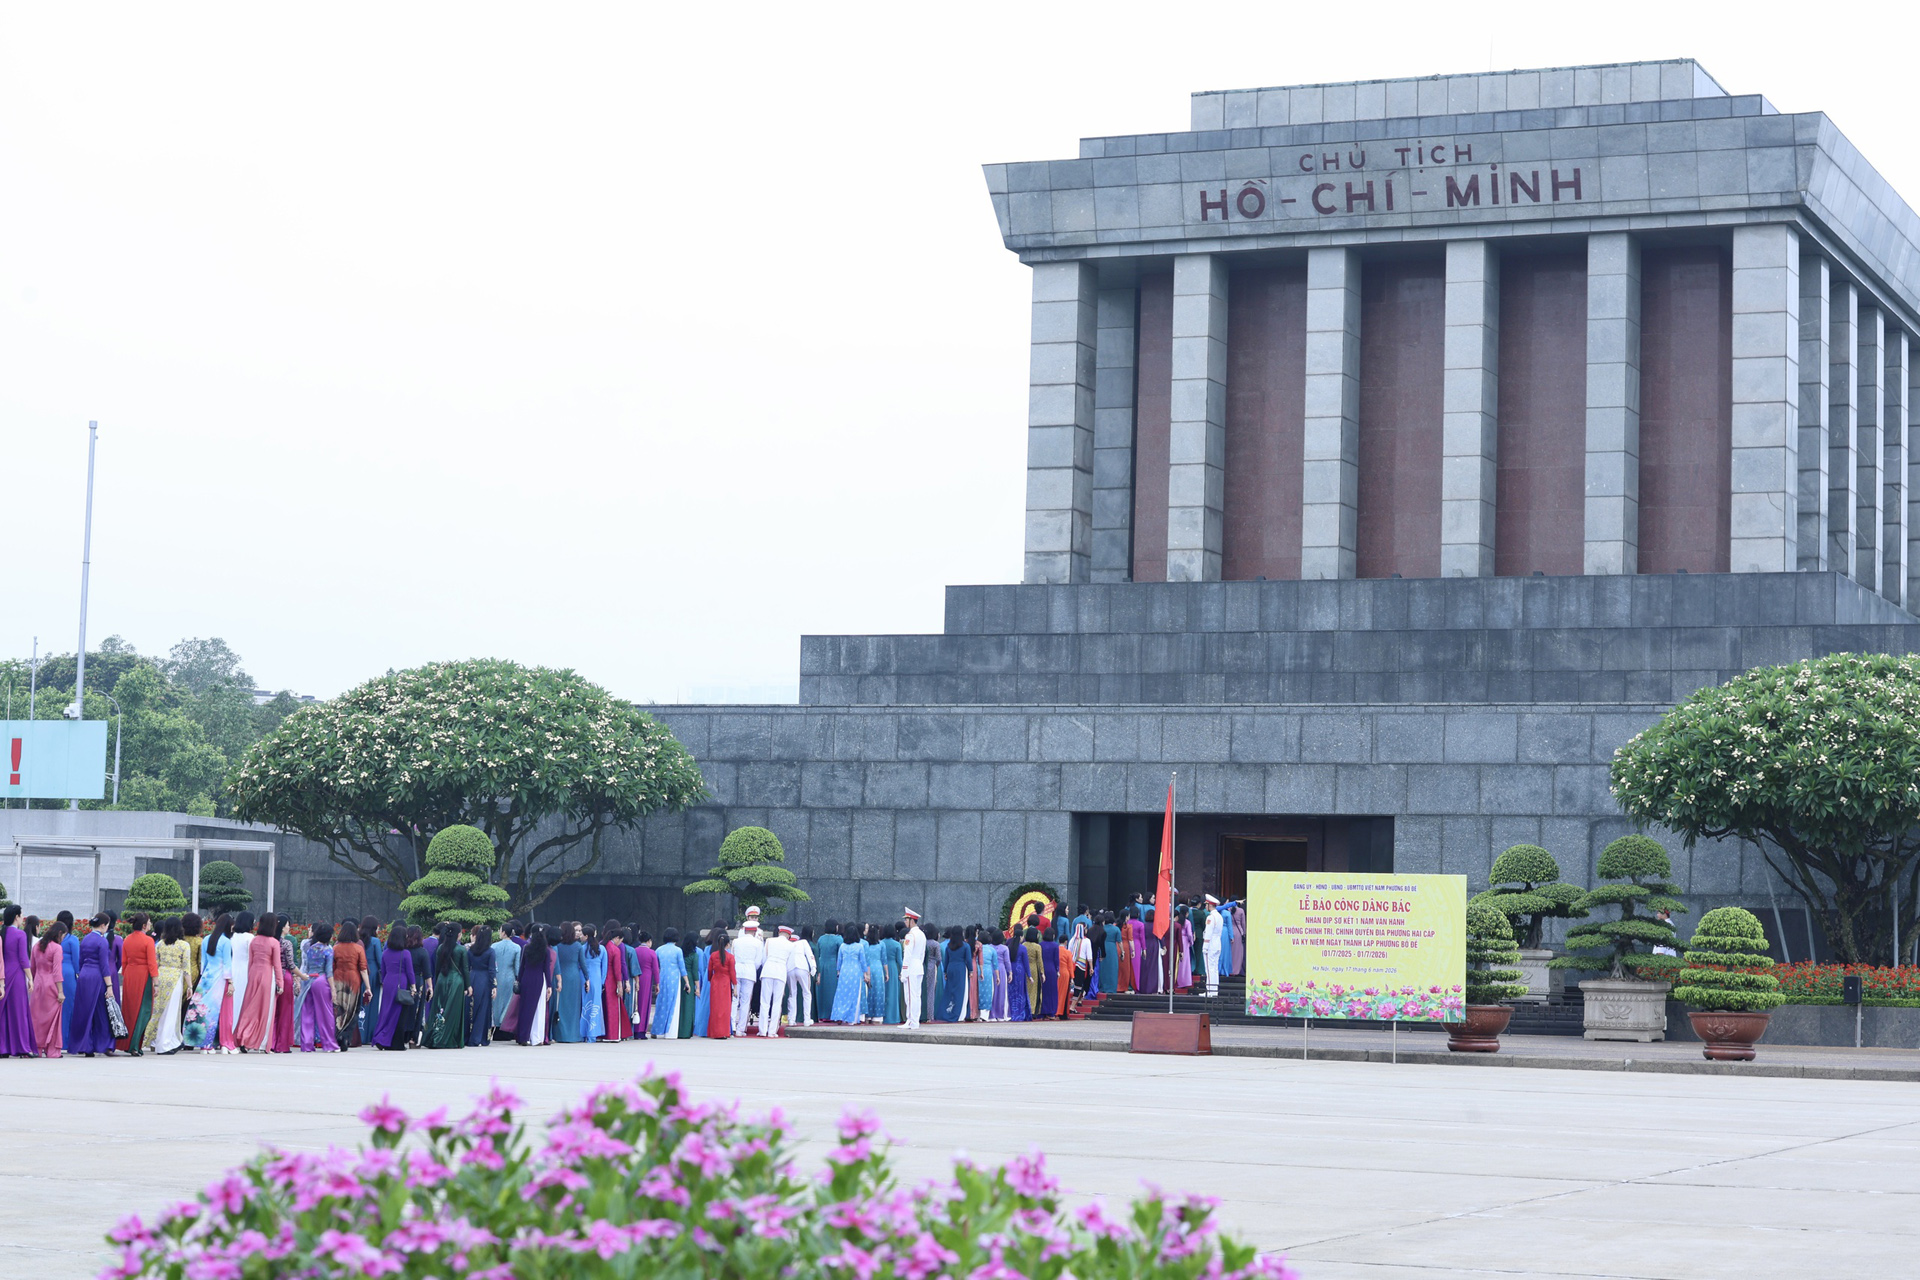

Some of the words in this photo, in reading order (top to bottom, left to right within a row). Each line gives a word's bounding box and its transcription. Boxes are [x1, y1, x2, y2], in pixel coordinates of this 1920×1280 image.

[1299, 143, 1366, 172] CHỦ
[1394, 139, 1472, 174] TỊCH
[1200, 179, 1266, 221] HỒ
[1312, 170, 1394, 215] CHÍ
[1445, 164, 1582, 208] MINH
[10, 738, 22, 785] !
[1300, 894, 1310, 910] LỄ
[1313, 897, 1331, 911] BÁO
[1334, 897, 1359, 911] CÔNG
[1363, 898, 1389, 912] DÂNG
[1392, 899, 1410, 912] BÁC
